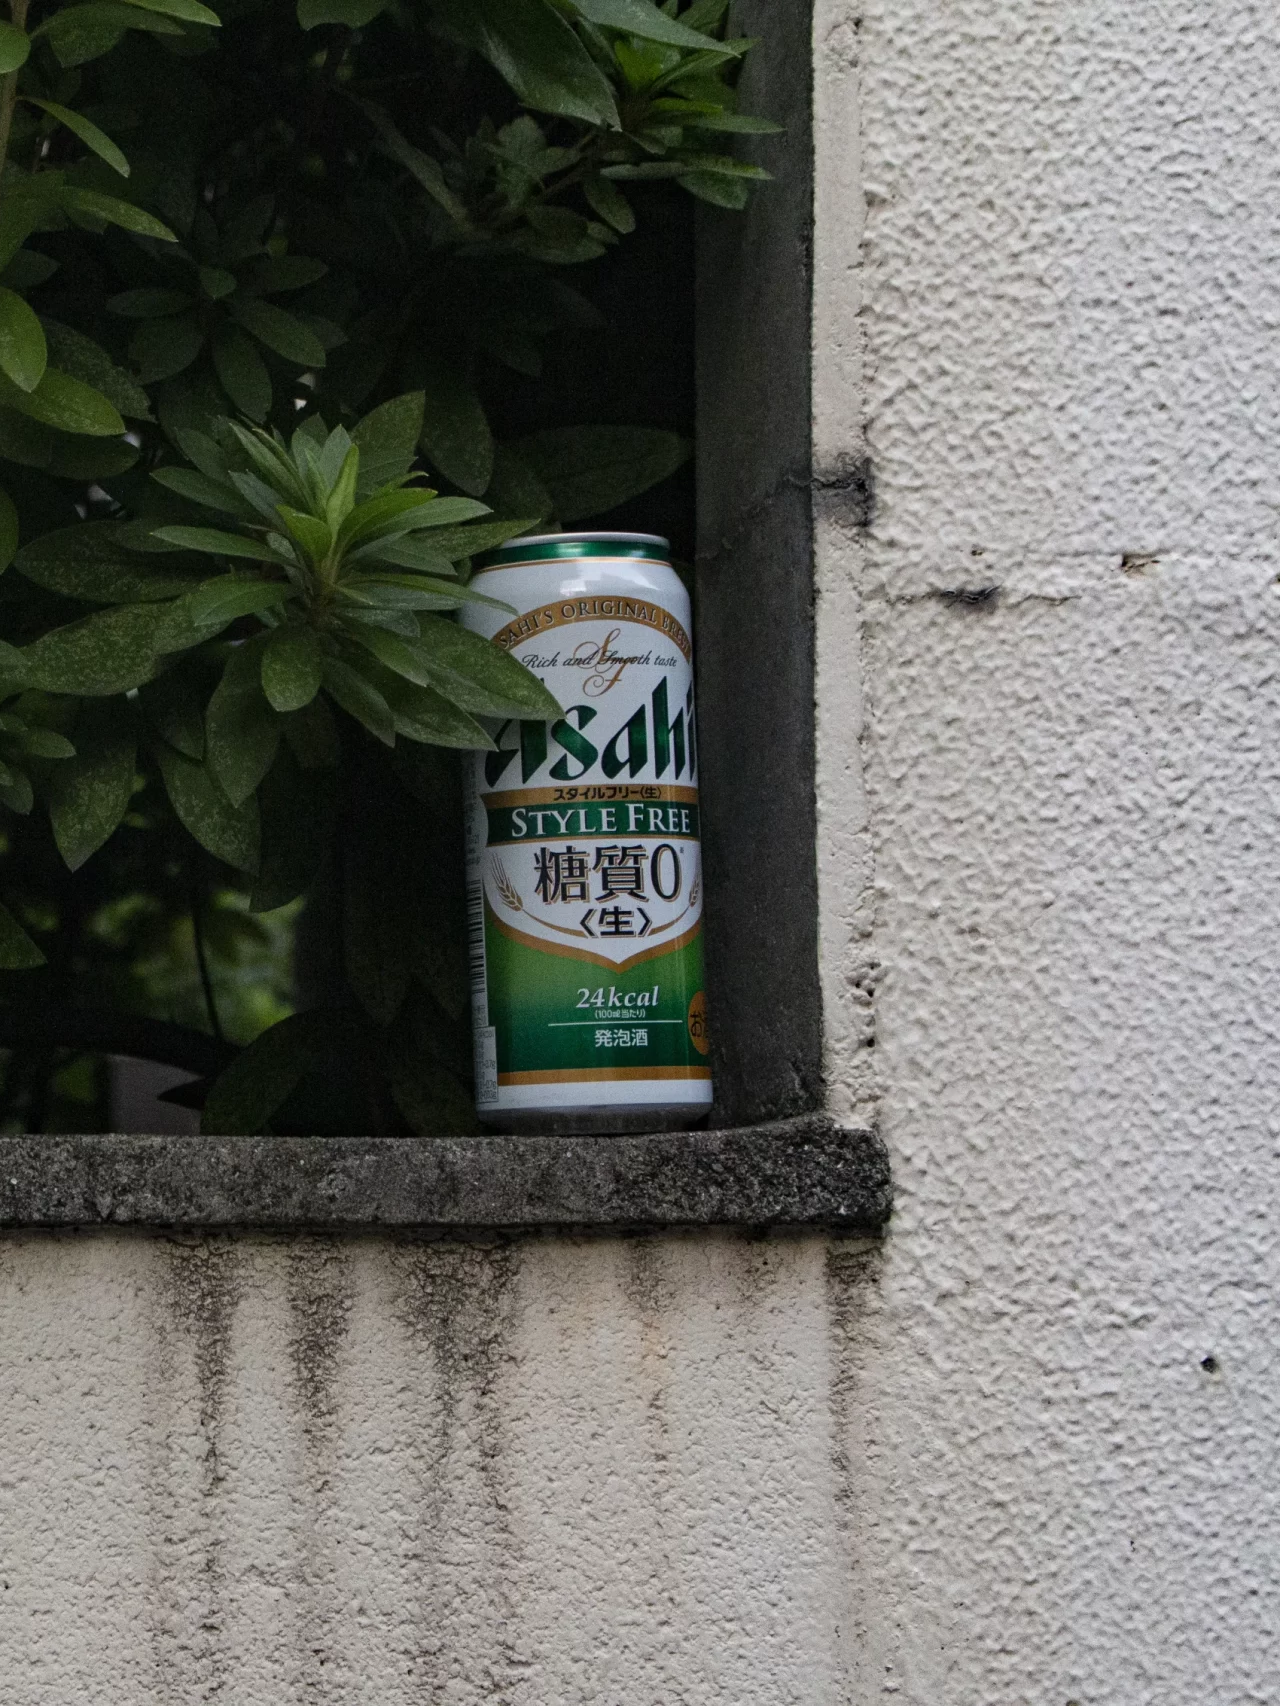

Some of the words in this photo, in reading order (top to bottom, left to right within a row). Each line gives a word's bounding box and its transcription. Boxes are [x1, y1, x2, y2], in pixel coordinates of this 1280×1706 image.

[499, 609, 553, 650] SAHI'S
[561, 600, 657, 625] ORIGINAL
[521, 652, 558, 670] Rich
[562, 651, 594, 667] and
[596, 649, 650, 668] Smooth
[653, 653, 677, 668] taste
[511, 807, 618, 838] STYLE
[624, 802, 691, 833] FREE
[575, 985, 659, 1009] 24kcal
[594, 1029, 648, 1047] 発泡酒
